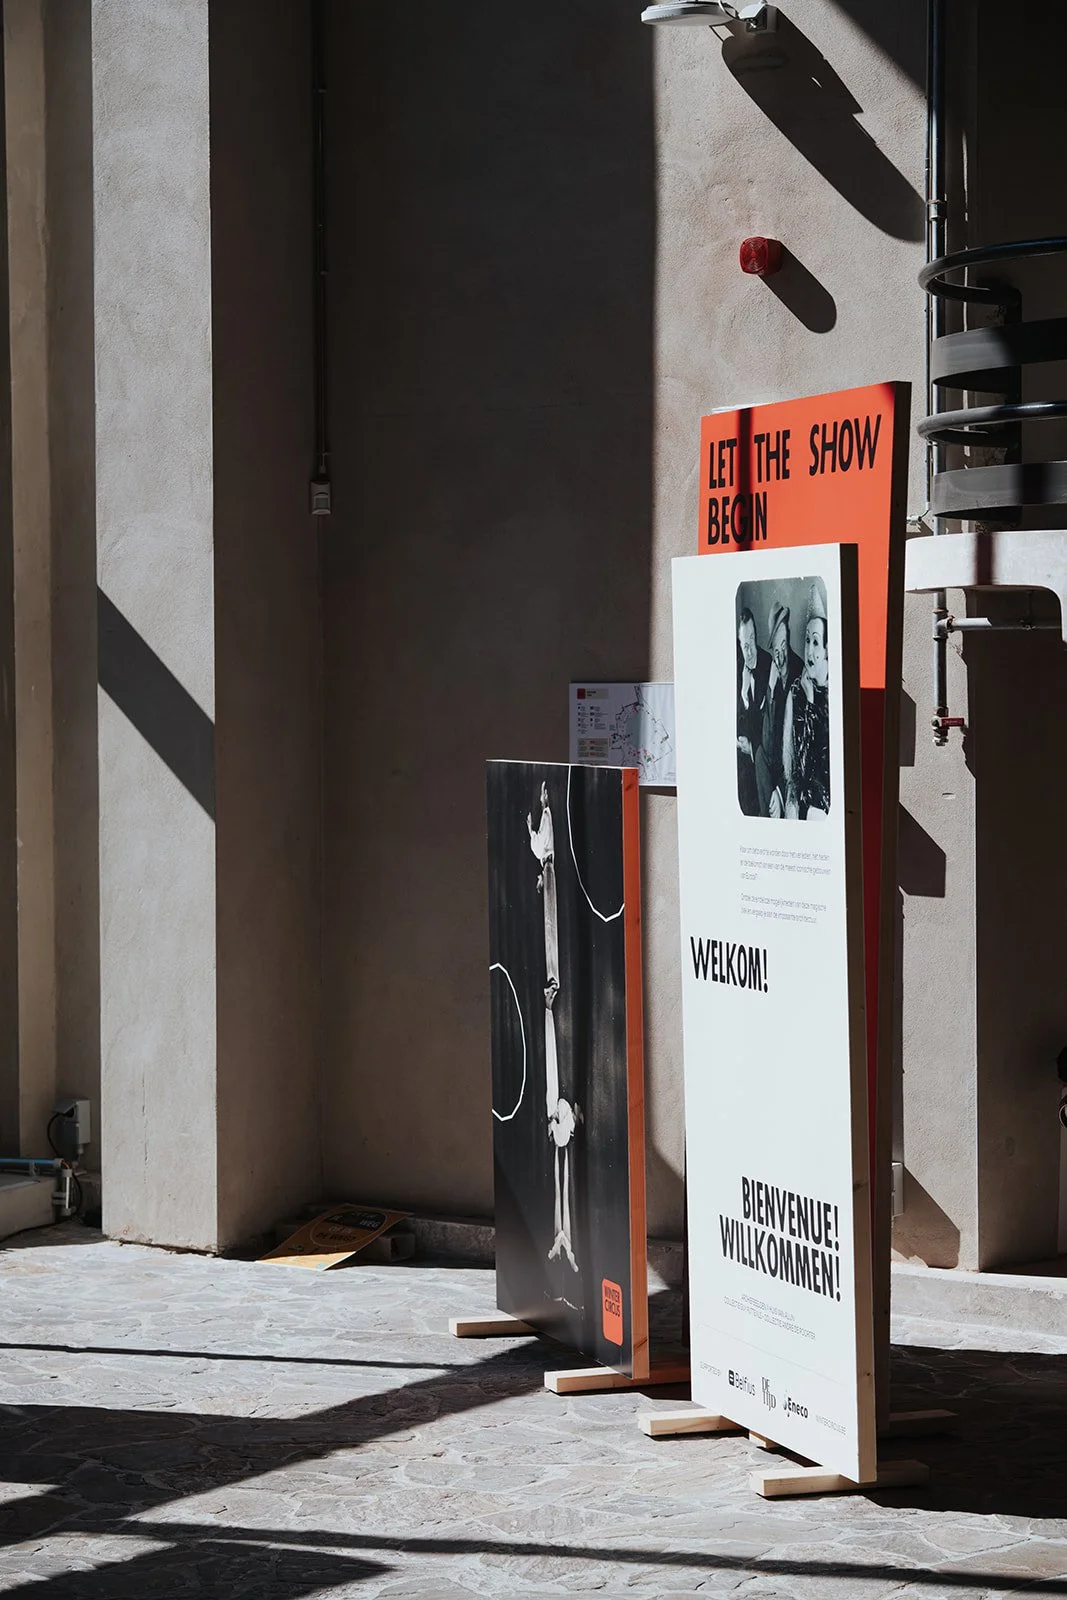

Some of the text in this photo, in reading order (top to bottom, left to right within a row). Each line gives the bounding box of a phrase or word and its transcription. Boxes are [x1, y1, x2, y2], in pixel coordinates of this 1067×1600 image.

[709, 414, 882, 490] LET THE SHOW
[707, 491, 767, 545] BEGIN
[690, 936, 769, 993] WELKOM!
[741, 1176, 840, 1252] BIENVENUE!
[719, 1214, 841, 1302] WILLKOMMEN!
[735, 1372, 756, 1396] Belfius
[787, 1397, 809, 1419] Eneco
